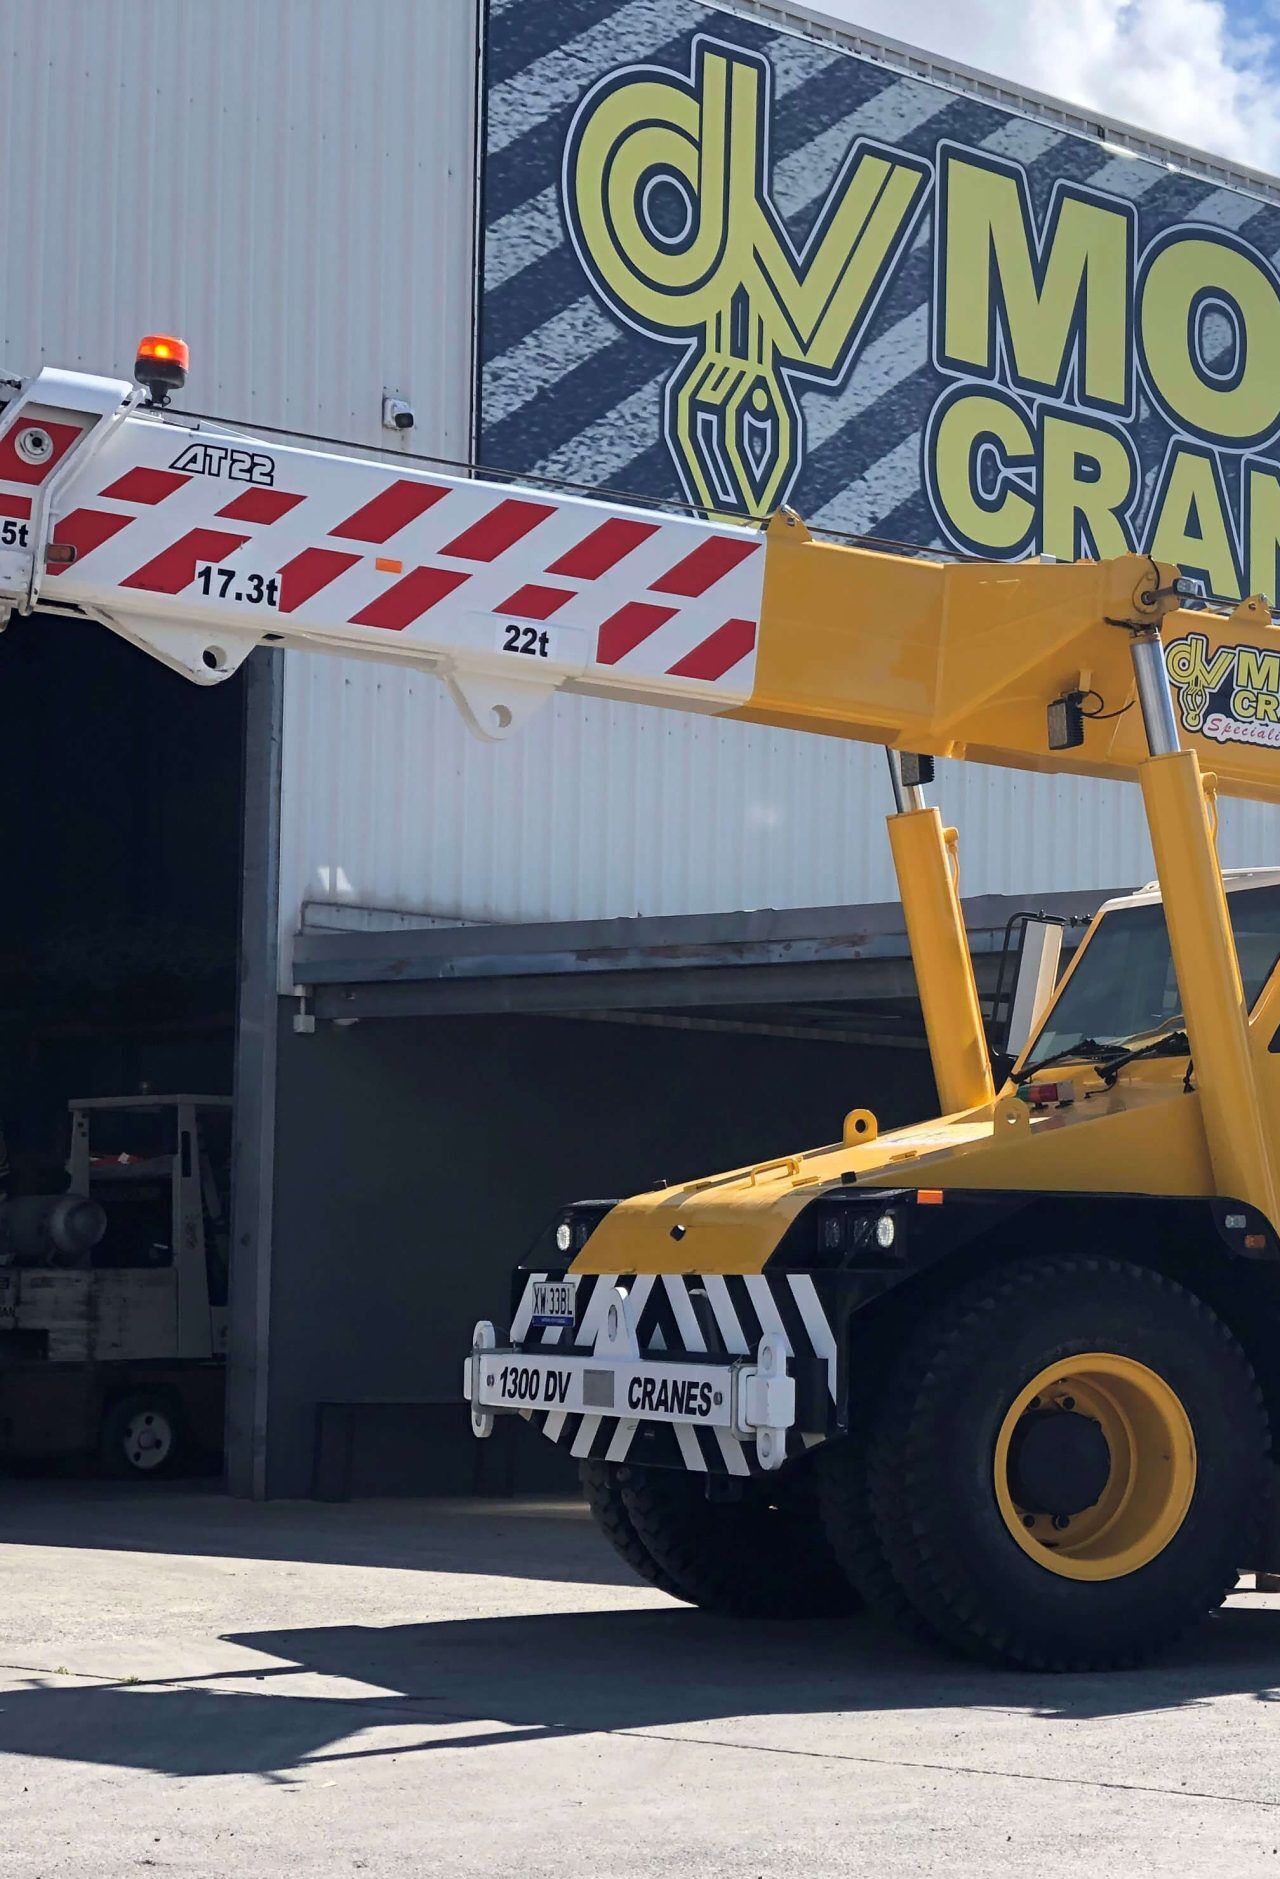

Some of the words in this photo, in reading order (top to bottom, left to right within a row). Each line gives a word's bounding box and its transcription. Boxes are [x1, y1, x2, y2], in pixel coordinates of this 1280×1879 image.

[197, 565, 279, 607] 17.3t
[502, 624, 550, 659] 22t
[499, 1366, 541, 1401] 1300
[543, 1370, 572, 1403] DV
[627, 1376, 713, 1417] CRANES
